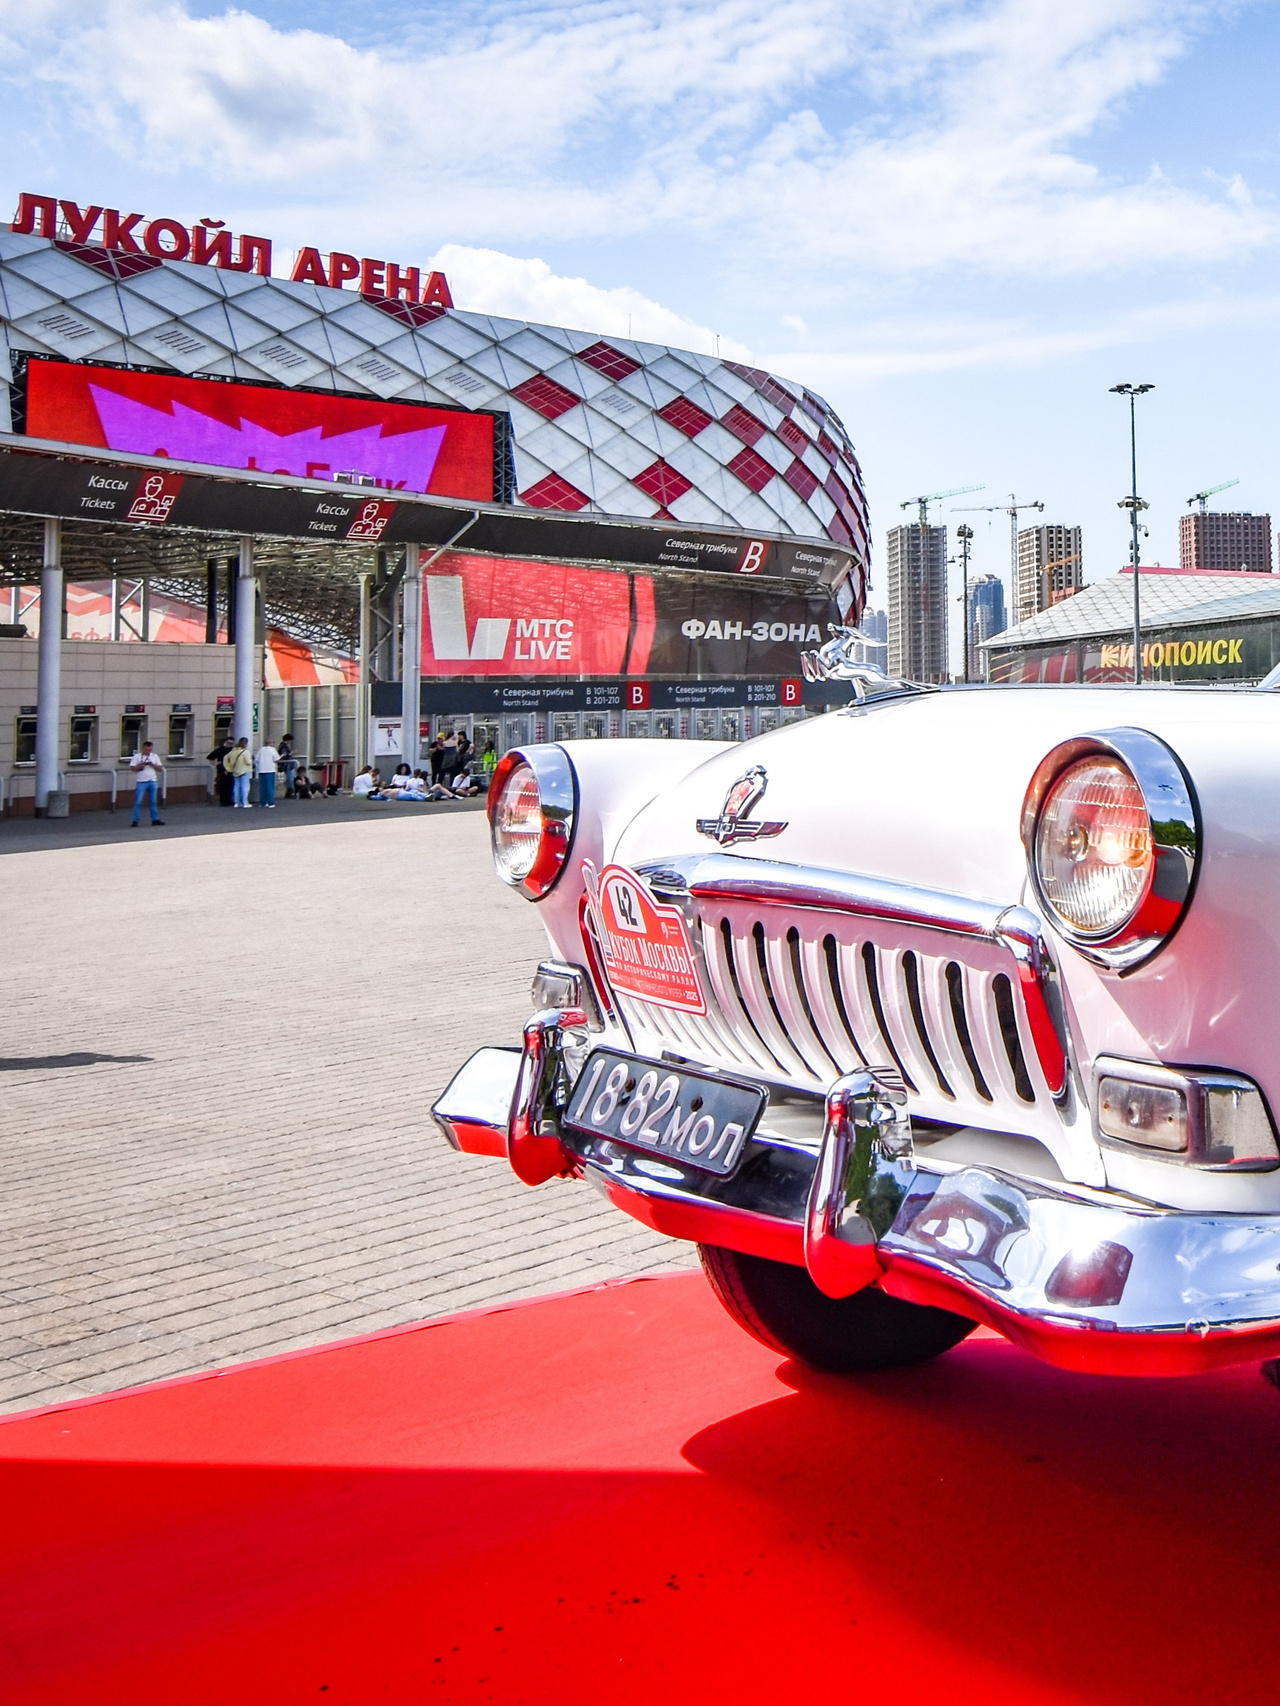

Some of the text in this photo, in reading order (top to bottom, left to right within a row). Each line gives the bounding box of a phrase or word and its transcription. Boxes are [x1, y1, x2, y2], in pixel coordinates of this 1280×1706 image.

[8, 191, 455, 309] ЛУКОЙЛ АРЕНА
[87, 475, 129, 491] Кассы
[80, 497, 116, 510] Tickets
[315, 502, 350, 517] Кассы
[308, 521, 338, 532] Tickets
[665, 538, 738, 555] Северная трибуна
[658, 552, 699, 563] North Stand
[791, 565, 807, 575] North
[515, 619, 574, 639] МТС
[681, 618, 823, 643] ФАН-ЗОНА
[514, 640, 573, 661] LIVE
[1100, 638, 1245, 669] КИНОПОИСК
[502, 687, 574, 698] Северная трибуна
[594, 687, 619, 695] 101-107
[675, 686, 735, 695] Северная трибуна
[593, 696, 620, 705] 201-210
[615, 885, 638, 927] 42
[608, 930, 692, 975] КУБОК МОСКВЫ
